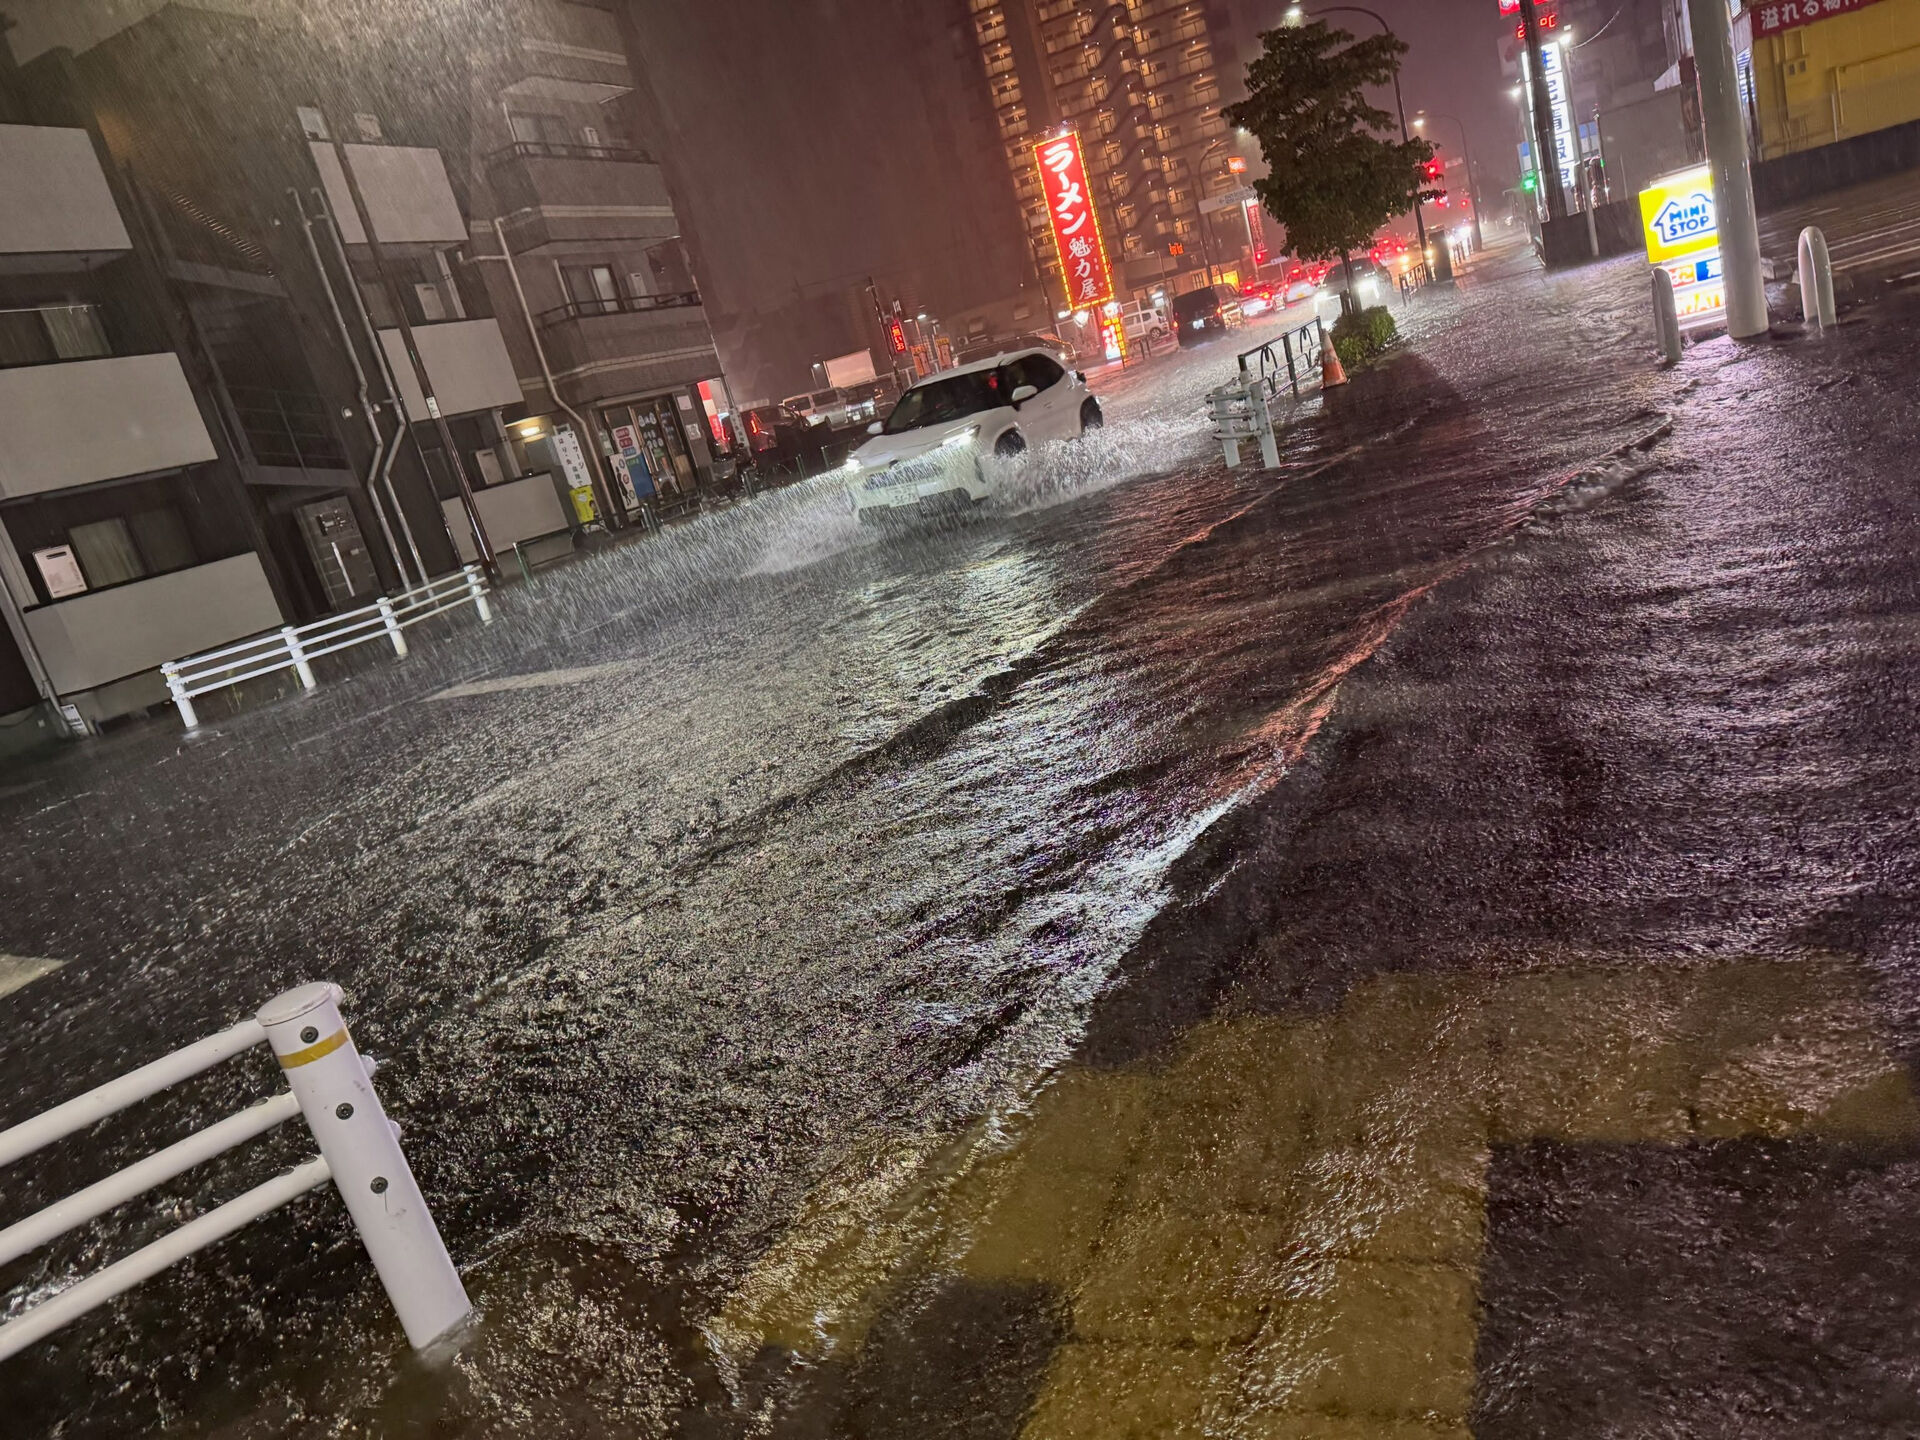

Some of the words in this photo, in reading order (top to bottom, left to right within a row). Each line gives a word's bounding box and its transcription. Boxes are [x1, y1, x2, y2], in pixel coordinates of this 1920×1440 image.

[1044, 142, 1087, 236] ラーメン
[1669, 204, 1707, 223] MINI
[1669, 216, 1710, 237] STOP
[1068, 235, 1098, 301] 魁力屋
